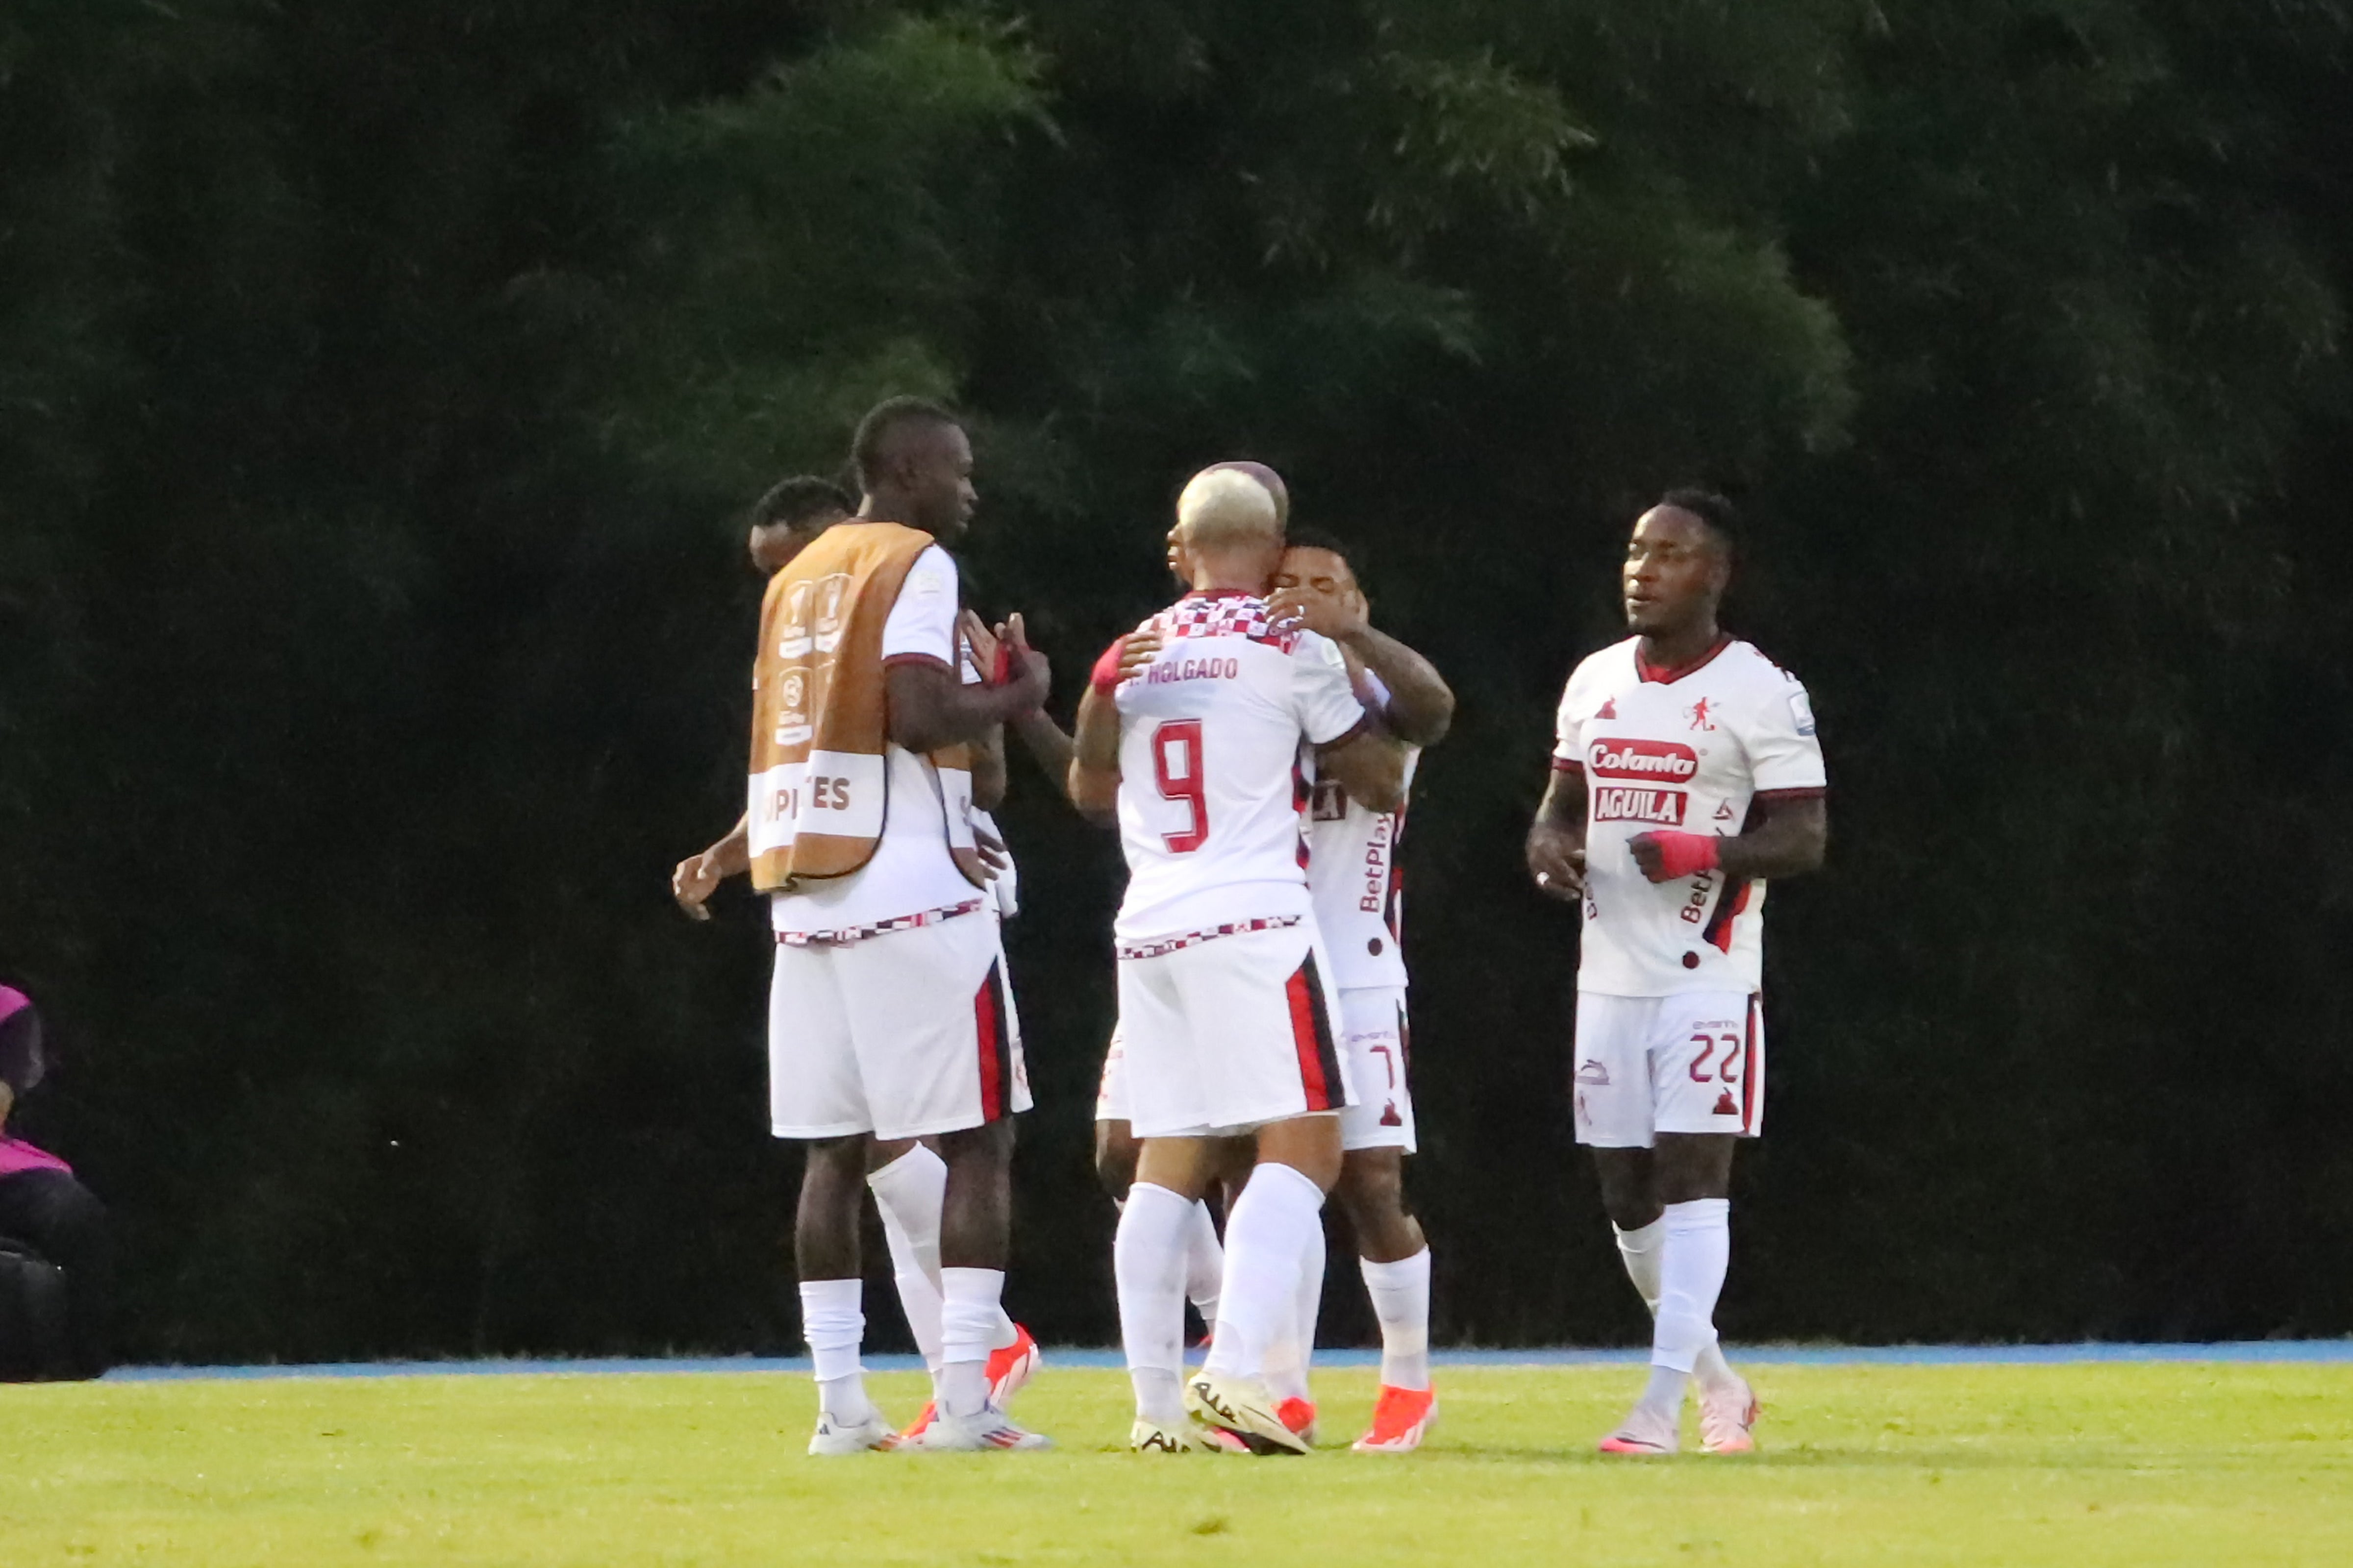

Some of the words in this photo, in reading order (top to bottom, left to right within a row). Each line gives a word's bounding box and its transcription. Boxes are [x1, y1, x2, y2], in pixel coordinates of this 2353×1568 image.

[1148, 657, 1239, 684] HOLGADO
[1589, 744, 1695, 774] Colanta
[1150, 718, 1208, 853] 9
[1597, 789, 1677, 822] AGUILA
[1359, 815, 1391, 913] BetPlay
[1370, 1045, 1395, 1090] 7
[1690, 1033, 1741, 1083] 22
